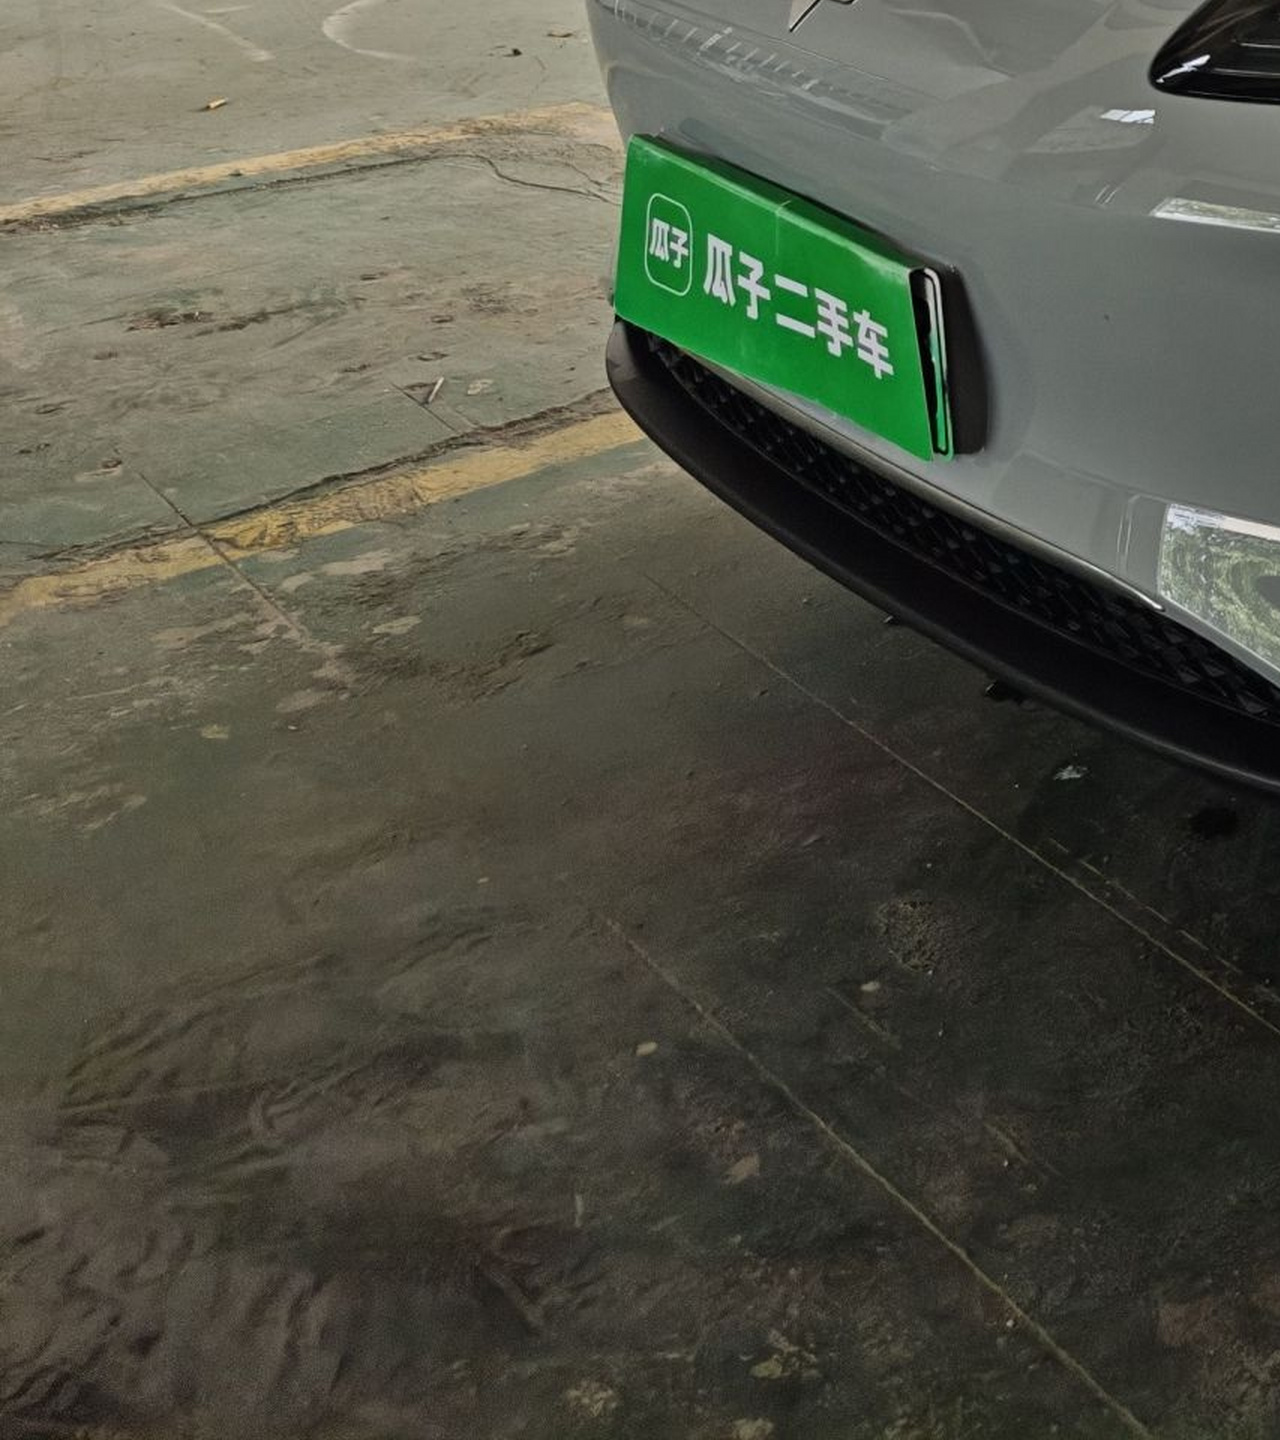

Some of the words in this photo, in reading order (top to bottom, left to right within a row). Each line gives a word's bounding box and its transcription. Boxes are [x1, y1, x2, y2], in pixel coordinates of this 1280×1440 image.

[649, 217, 690, 268] 瓜子
[703, 233, 895, 381] 瓜子二手车
